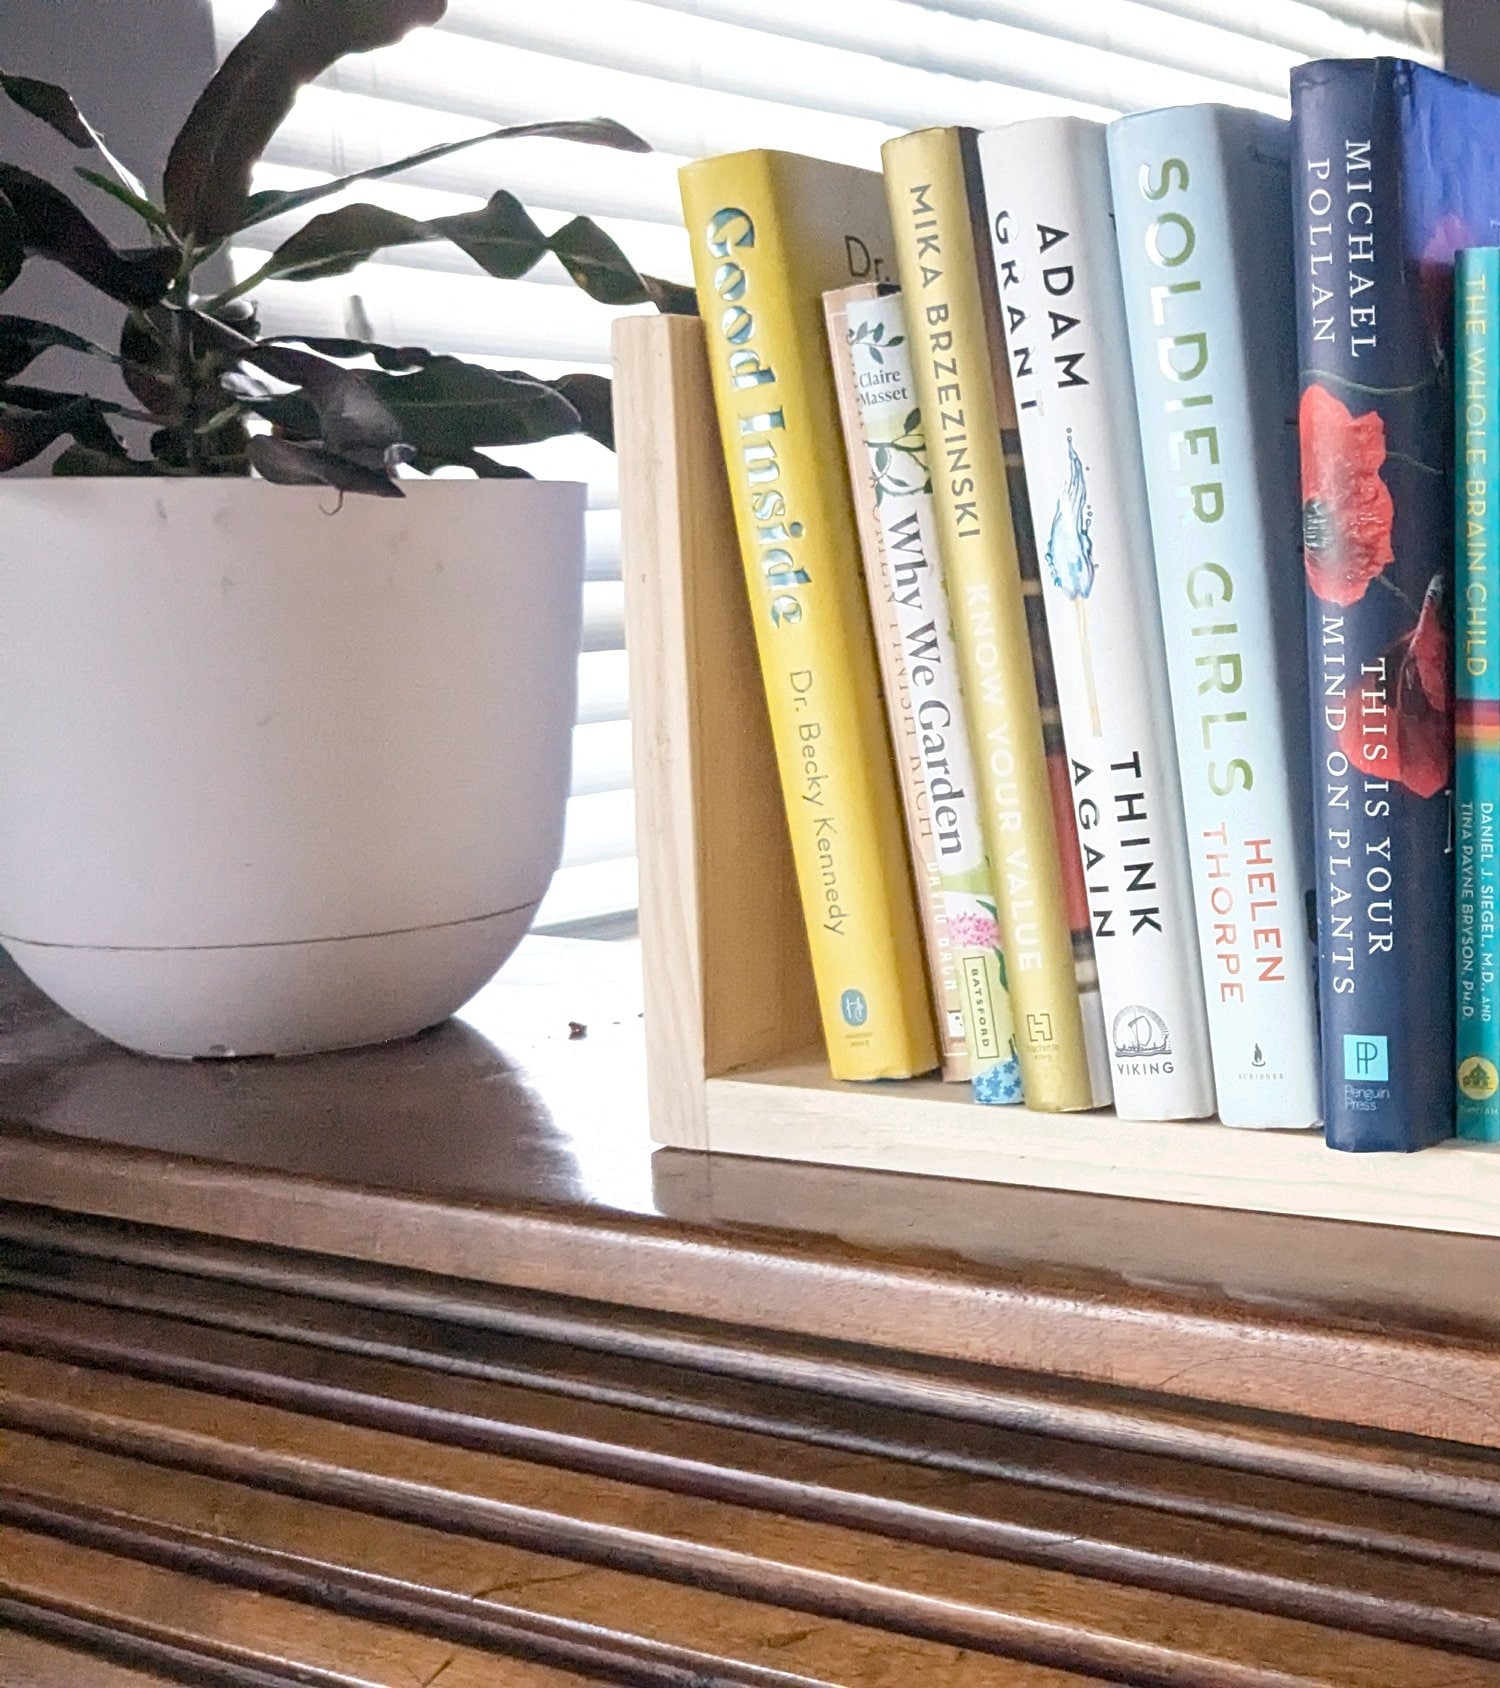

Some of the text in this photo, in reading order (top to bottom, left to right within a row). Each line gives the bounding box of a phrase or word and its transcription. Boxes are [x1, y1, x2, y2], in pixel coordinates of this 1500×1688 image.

[1036, 223, 1090, 388] ADAM
[1307, 157, 1336, 343] POLLAN
[1345, 139, 1377, 358] MICHAEL
[707, 206, 812, 629] Good Inside
[859, 370, 900, 388] Claire
[909, 184, 981, 539] MIKA BRZEZINSKI
[1138, 157, 1254, 797] SOLDIER GIRLS
[1464, 274, 1488, 677] THE WHOLE-BRAIN CHILD
[888, 511, 929, 610] Why
[906, 619, 941, 688] We
[790, 670, 850, 936] Dr. Becky Kennedy
[918, 700, 966, 856] Garden
[966, 583, 1042, 972] KNOW YOUR VALUE
[1071, 758, 1116, 937] AGAIN
[1110, 750, 1163, 937] THINK
[1322, 615, 1356, 995] MIND ON PLANTS
[1360, 657, 1395, 954] THIS IS YOUR
[1462, 802, 1474, 840] TINA
[1481, 803, 1494, 862] DANIEL
[1203, 821, 1245, 1004] THORPE
[1243, 838, 1285, 983] HELEN
[1462, 845, 1474, 898] PAYNE
[1481, 868, 1494, 880] J.
[970, 968, 990, 1048] BATSFORD
[1116, 1060, 1174, 1076] VIKING
[1481, 996, 1492, 1022] AND
[1344, 1084, 1390, 1101] Penguin
[1344, 1098, 1378, 1112] Press
